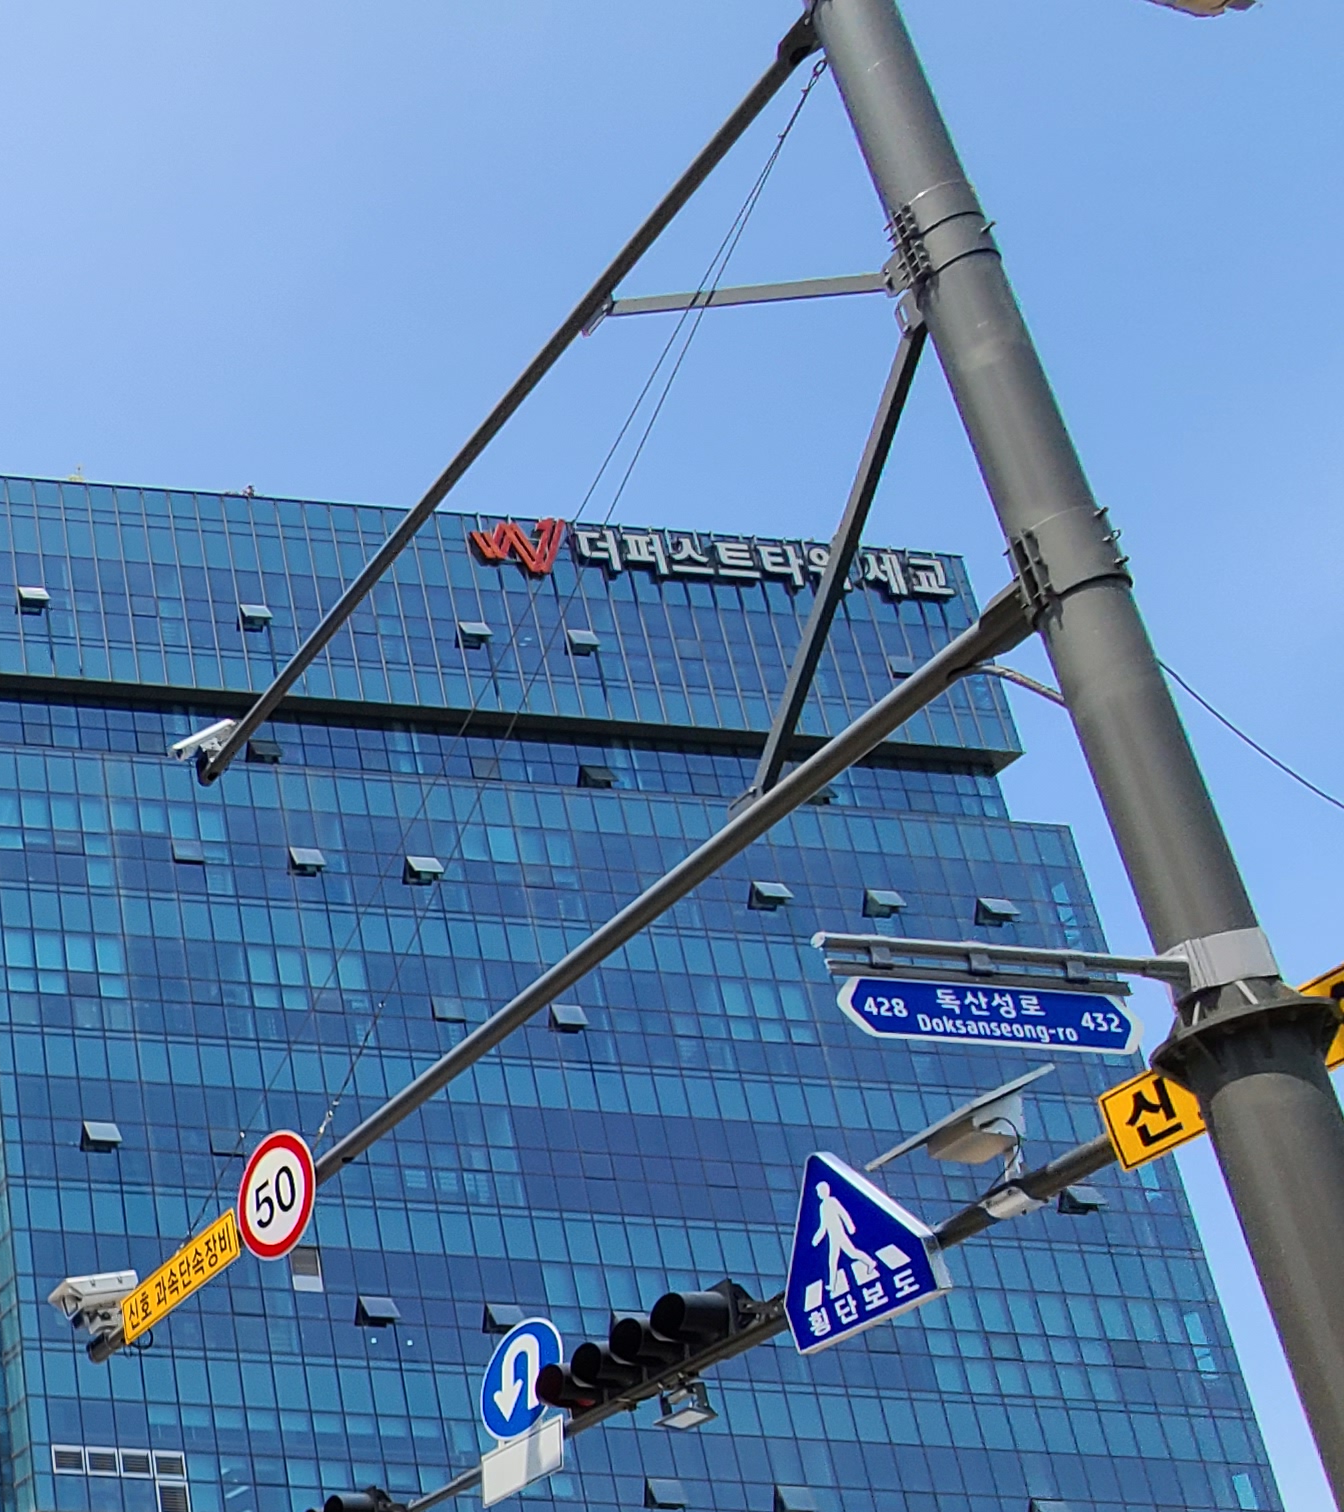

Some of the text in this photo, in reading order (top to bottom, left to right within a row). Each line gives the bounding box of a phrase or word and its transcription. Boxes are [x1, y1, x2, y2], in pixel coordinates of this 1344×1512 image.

[864, 557, 954, 597] 세교
[863, 995, 909, 1020] 428
[935, 987, 1046, 1018] 독산성로
[917, 1013, 1079, 1044] Doksanseong-ro
[1081, 1011, 1123, 1035] 432
[255, 1164, 296, 1230] 50
[126, 1230, 234, 1330] 신호 과속단속장비
[808, 1268, 921, 1337] 횡단보도
